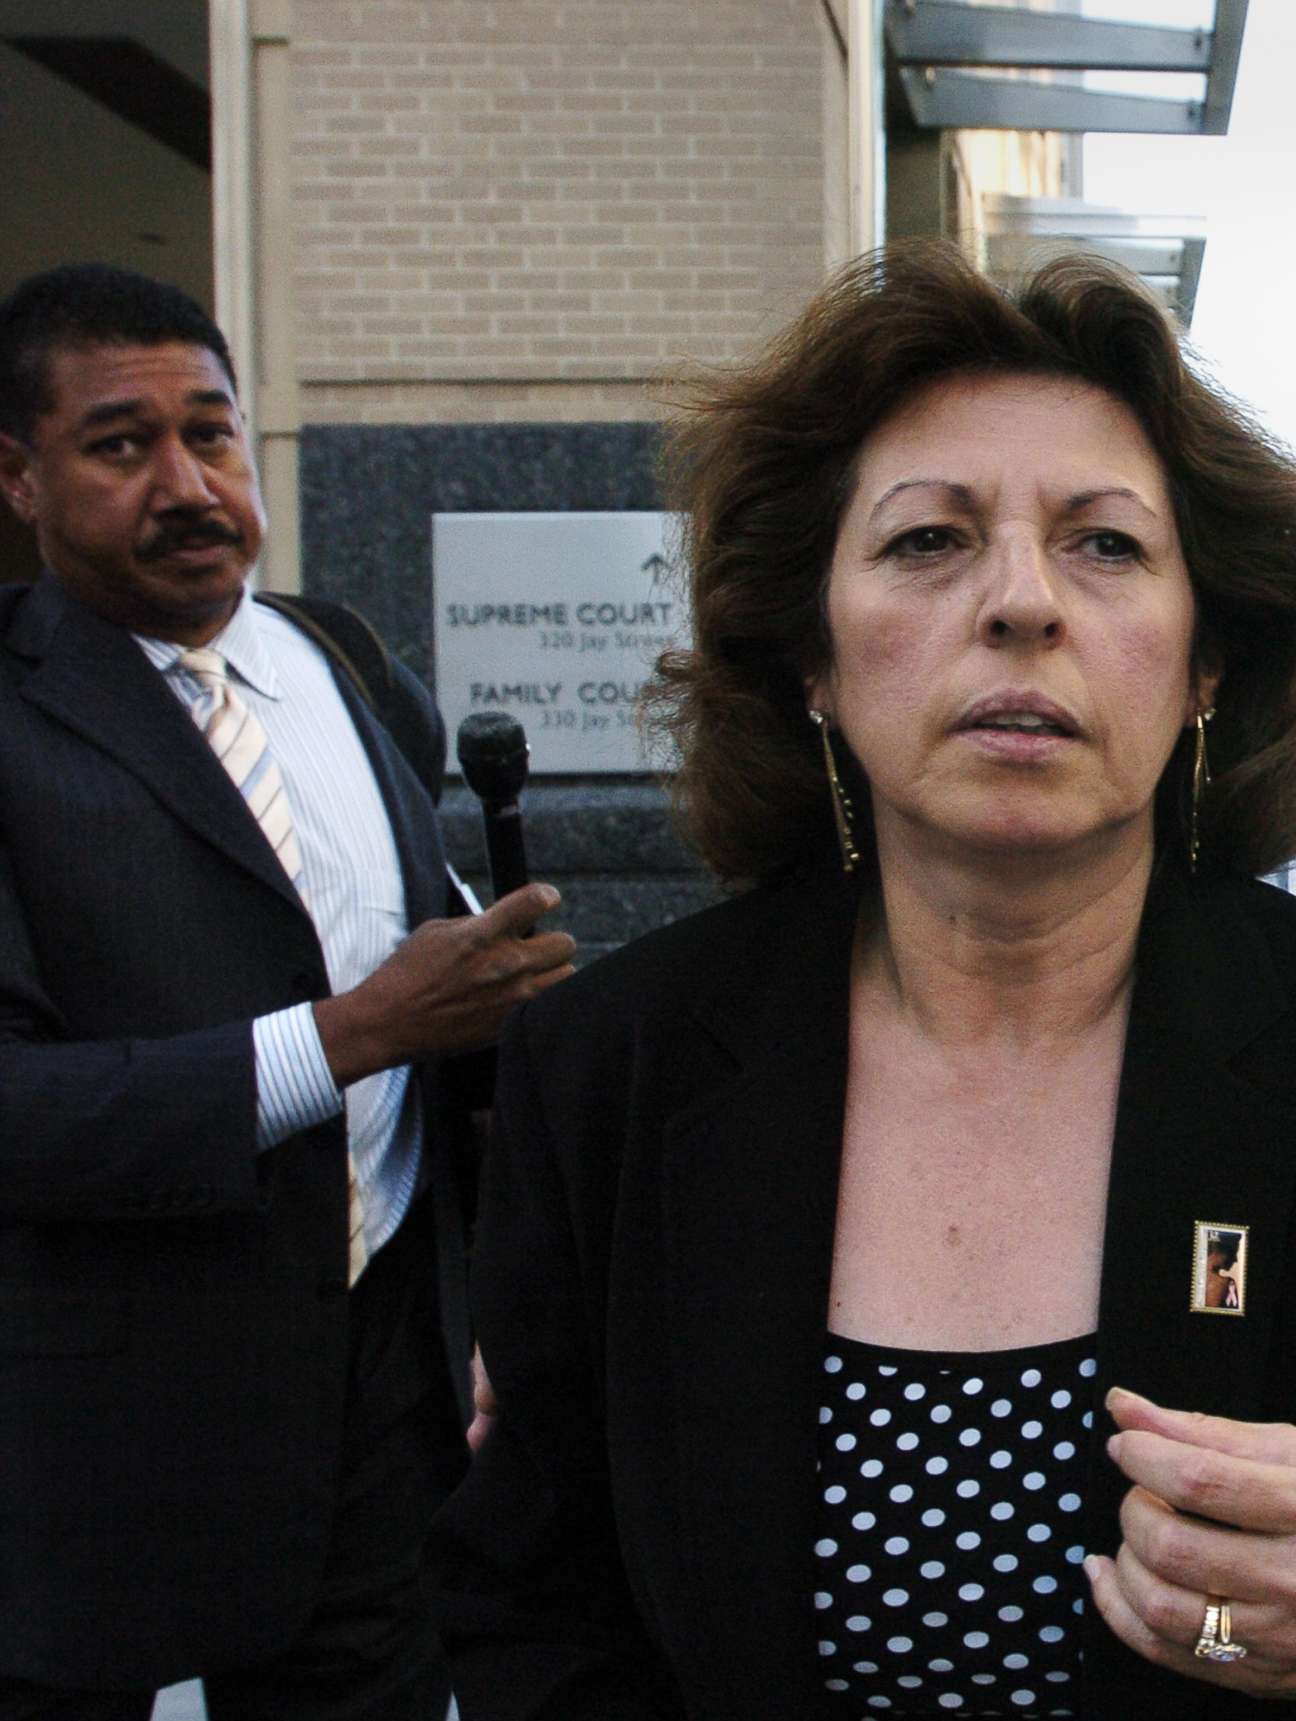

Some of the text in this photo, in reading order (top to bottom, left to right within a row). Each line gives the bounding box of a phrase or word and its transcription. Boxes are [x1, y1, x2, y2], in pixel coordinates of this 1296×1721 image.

[446, 602, 672, 627] SUPREME COURT
[578, 632, 608, 653] Jay
[469, 681, 641, 705] FAMILY COU
[581, 710, 610, 732] Jay
